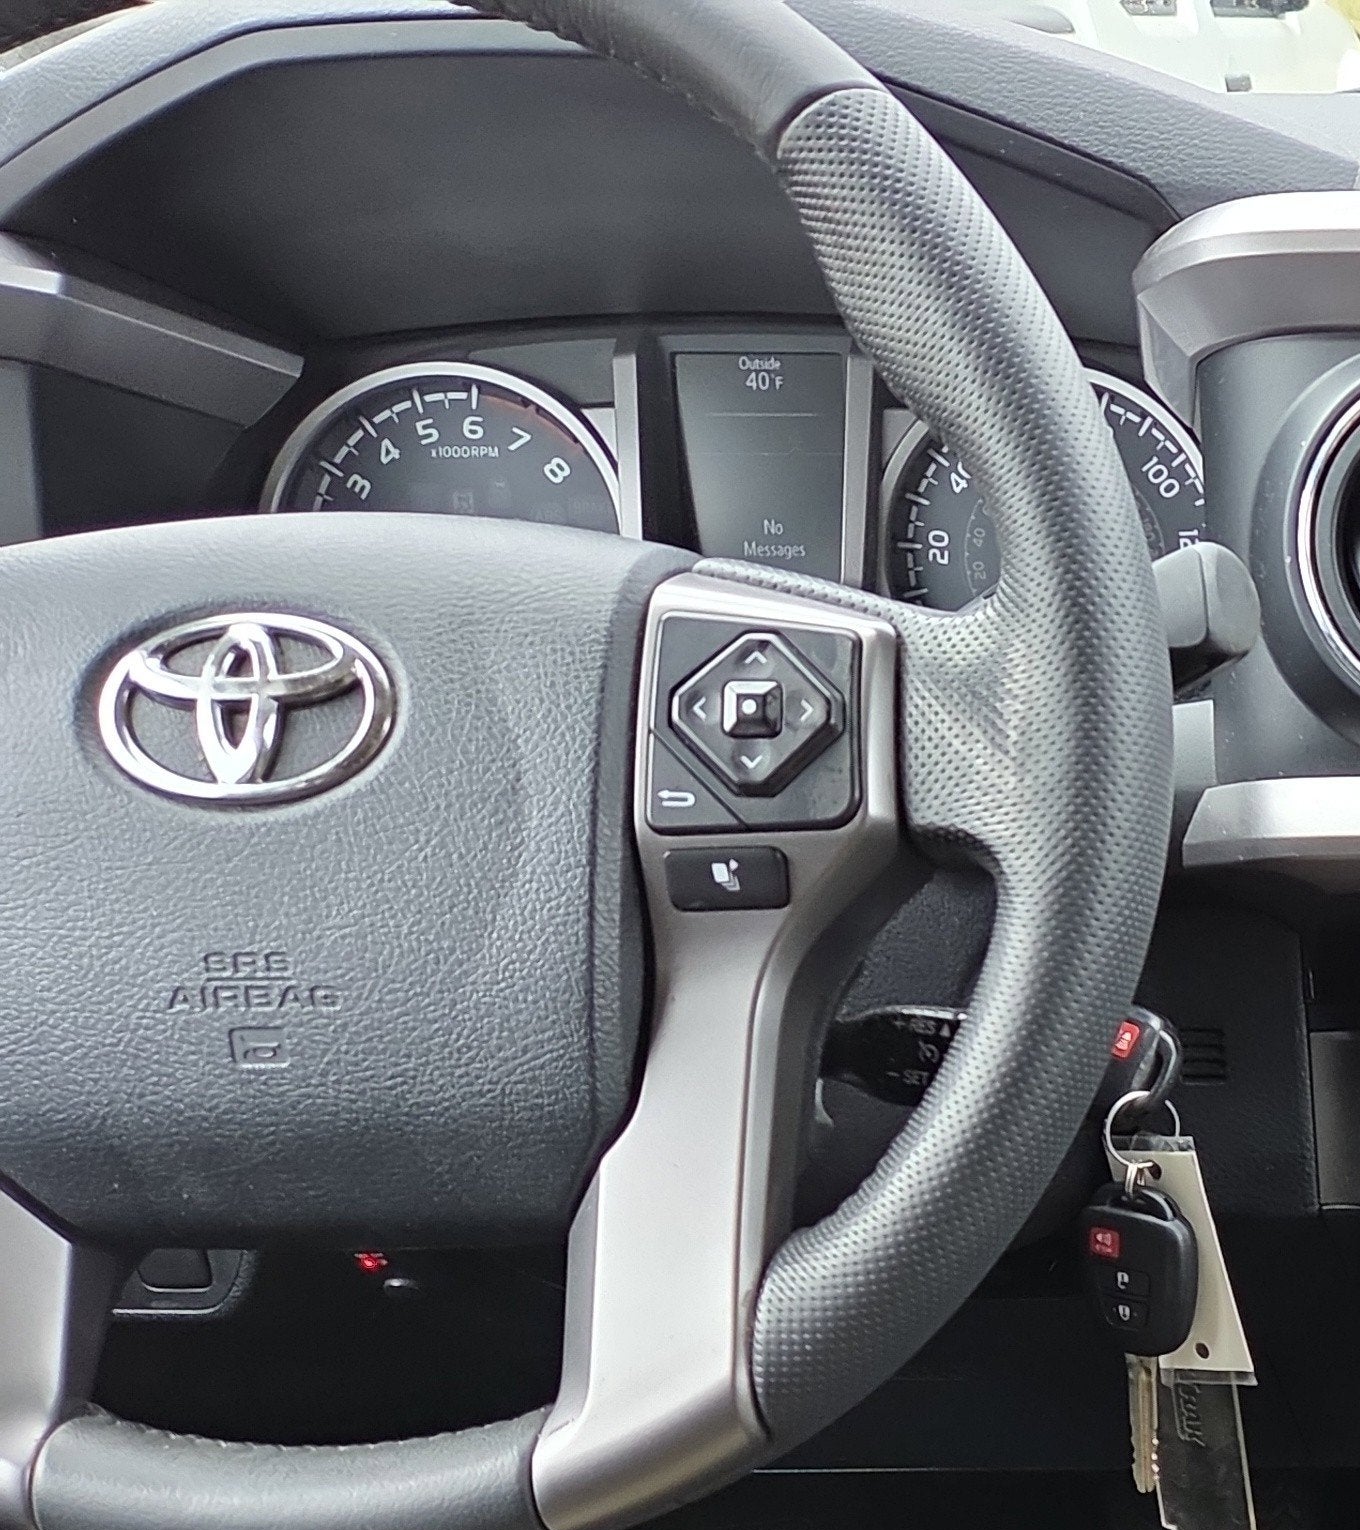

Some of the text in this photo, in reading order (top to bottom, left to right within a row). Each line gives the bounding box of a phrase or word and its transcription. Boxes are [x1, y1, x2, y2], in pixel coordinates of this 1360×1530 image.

[738, 356, 781, 371] Outside
[414, 417, 440, 446] 5
[463, 415, 485, 440] 6
[506, 426, 533, 452] 7
[379, 437, 401, 466] 4
[543, 456, 572, 485] 8
[1141, 455, 1180, 498] 100
[346, 472, 372, 501] 3
[763, 518, 784, 536] No
[973, 527, 986, 548] 40
[743, 539, 806, 561] Messages
[928, 529, 950, 566] 20
[972, 560, 987, 580] 20
[203, 951, 292, 976] SRS
[167, 985, 343, 1012] AIRBAG
[909, 1017, 937, 1036] RES
